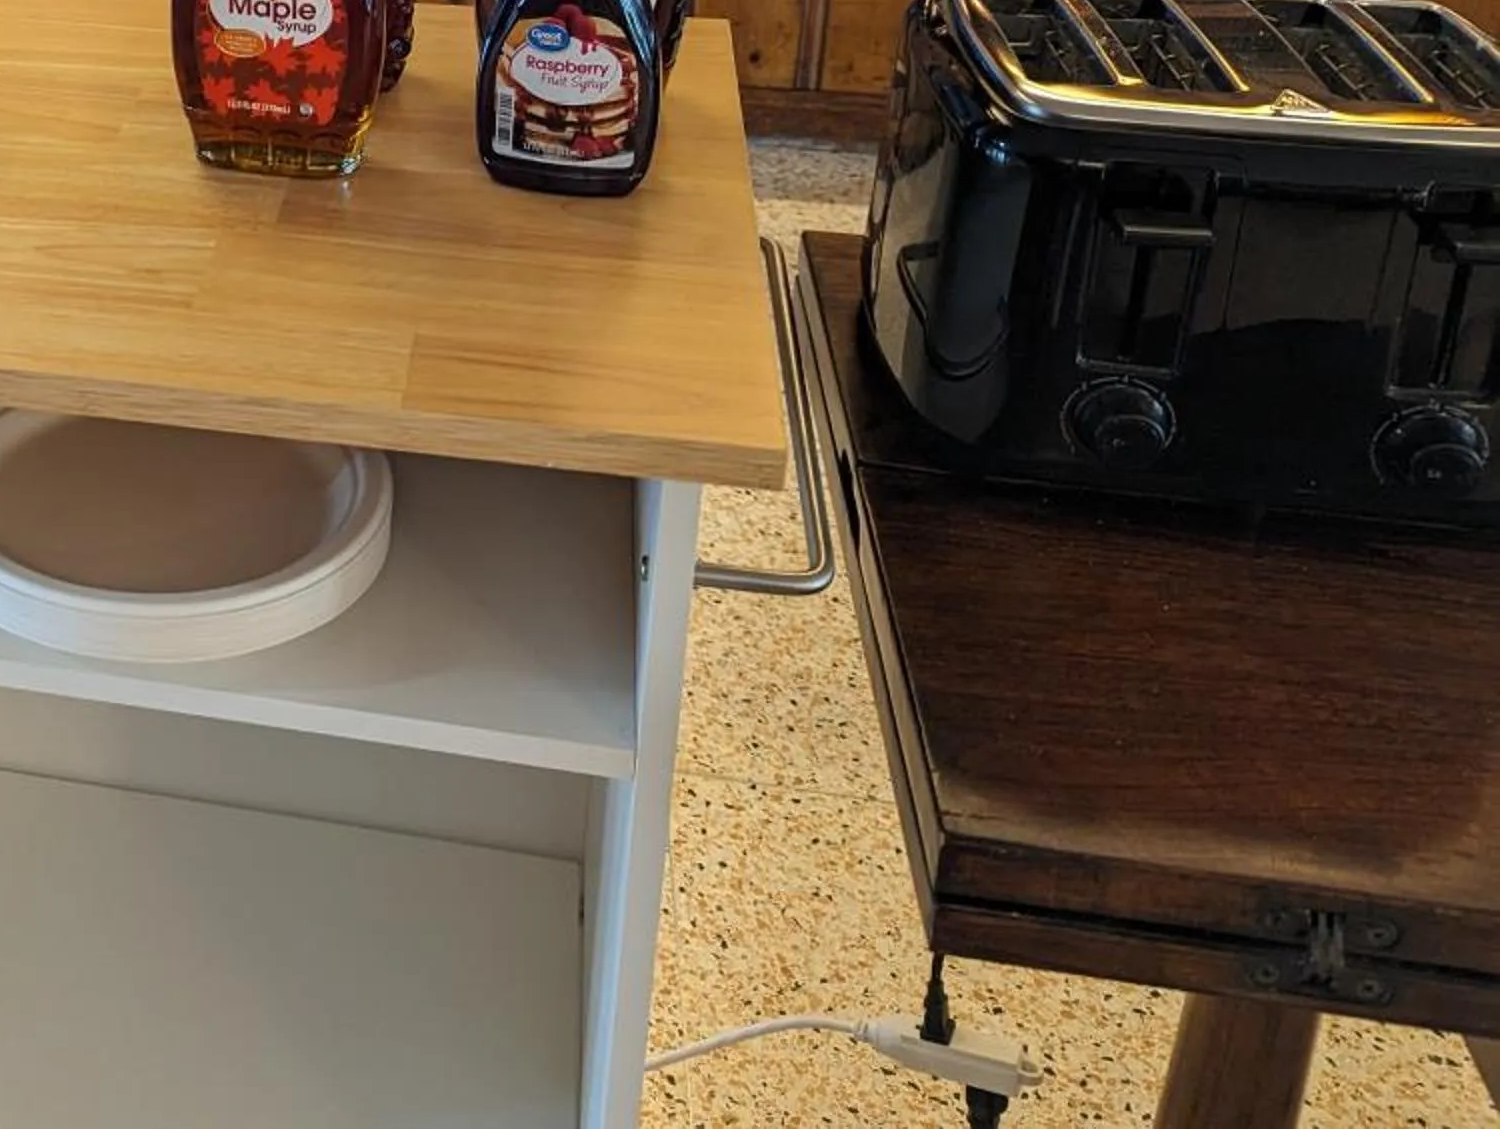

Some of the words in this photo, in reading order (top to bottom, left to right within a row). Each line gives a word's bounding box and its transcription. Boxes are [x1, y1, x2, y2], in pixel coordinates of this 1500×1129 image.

[277, 21, 317, 35] Syrup
[526, 53, 611, 78] Raspberry
[541, 72, 570, 88] Fruit
[571, 74, 610, 95] Syrup
